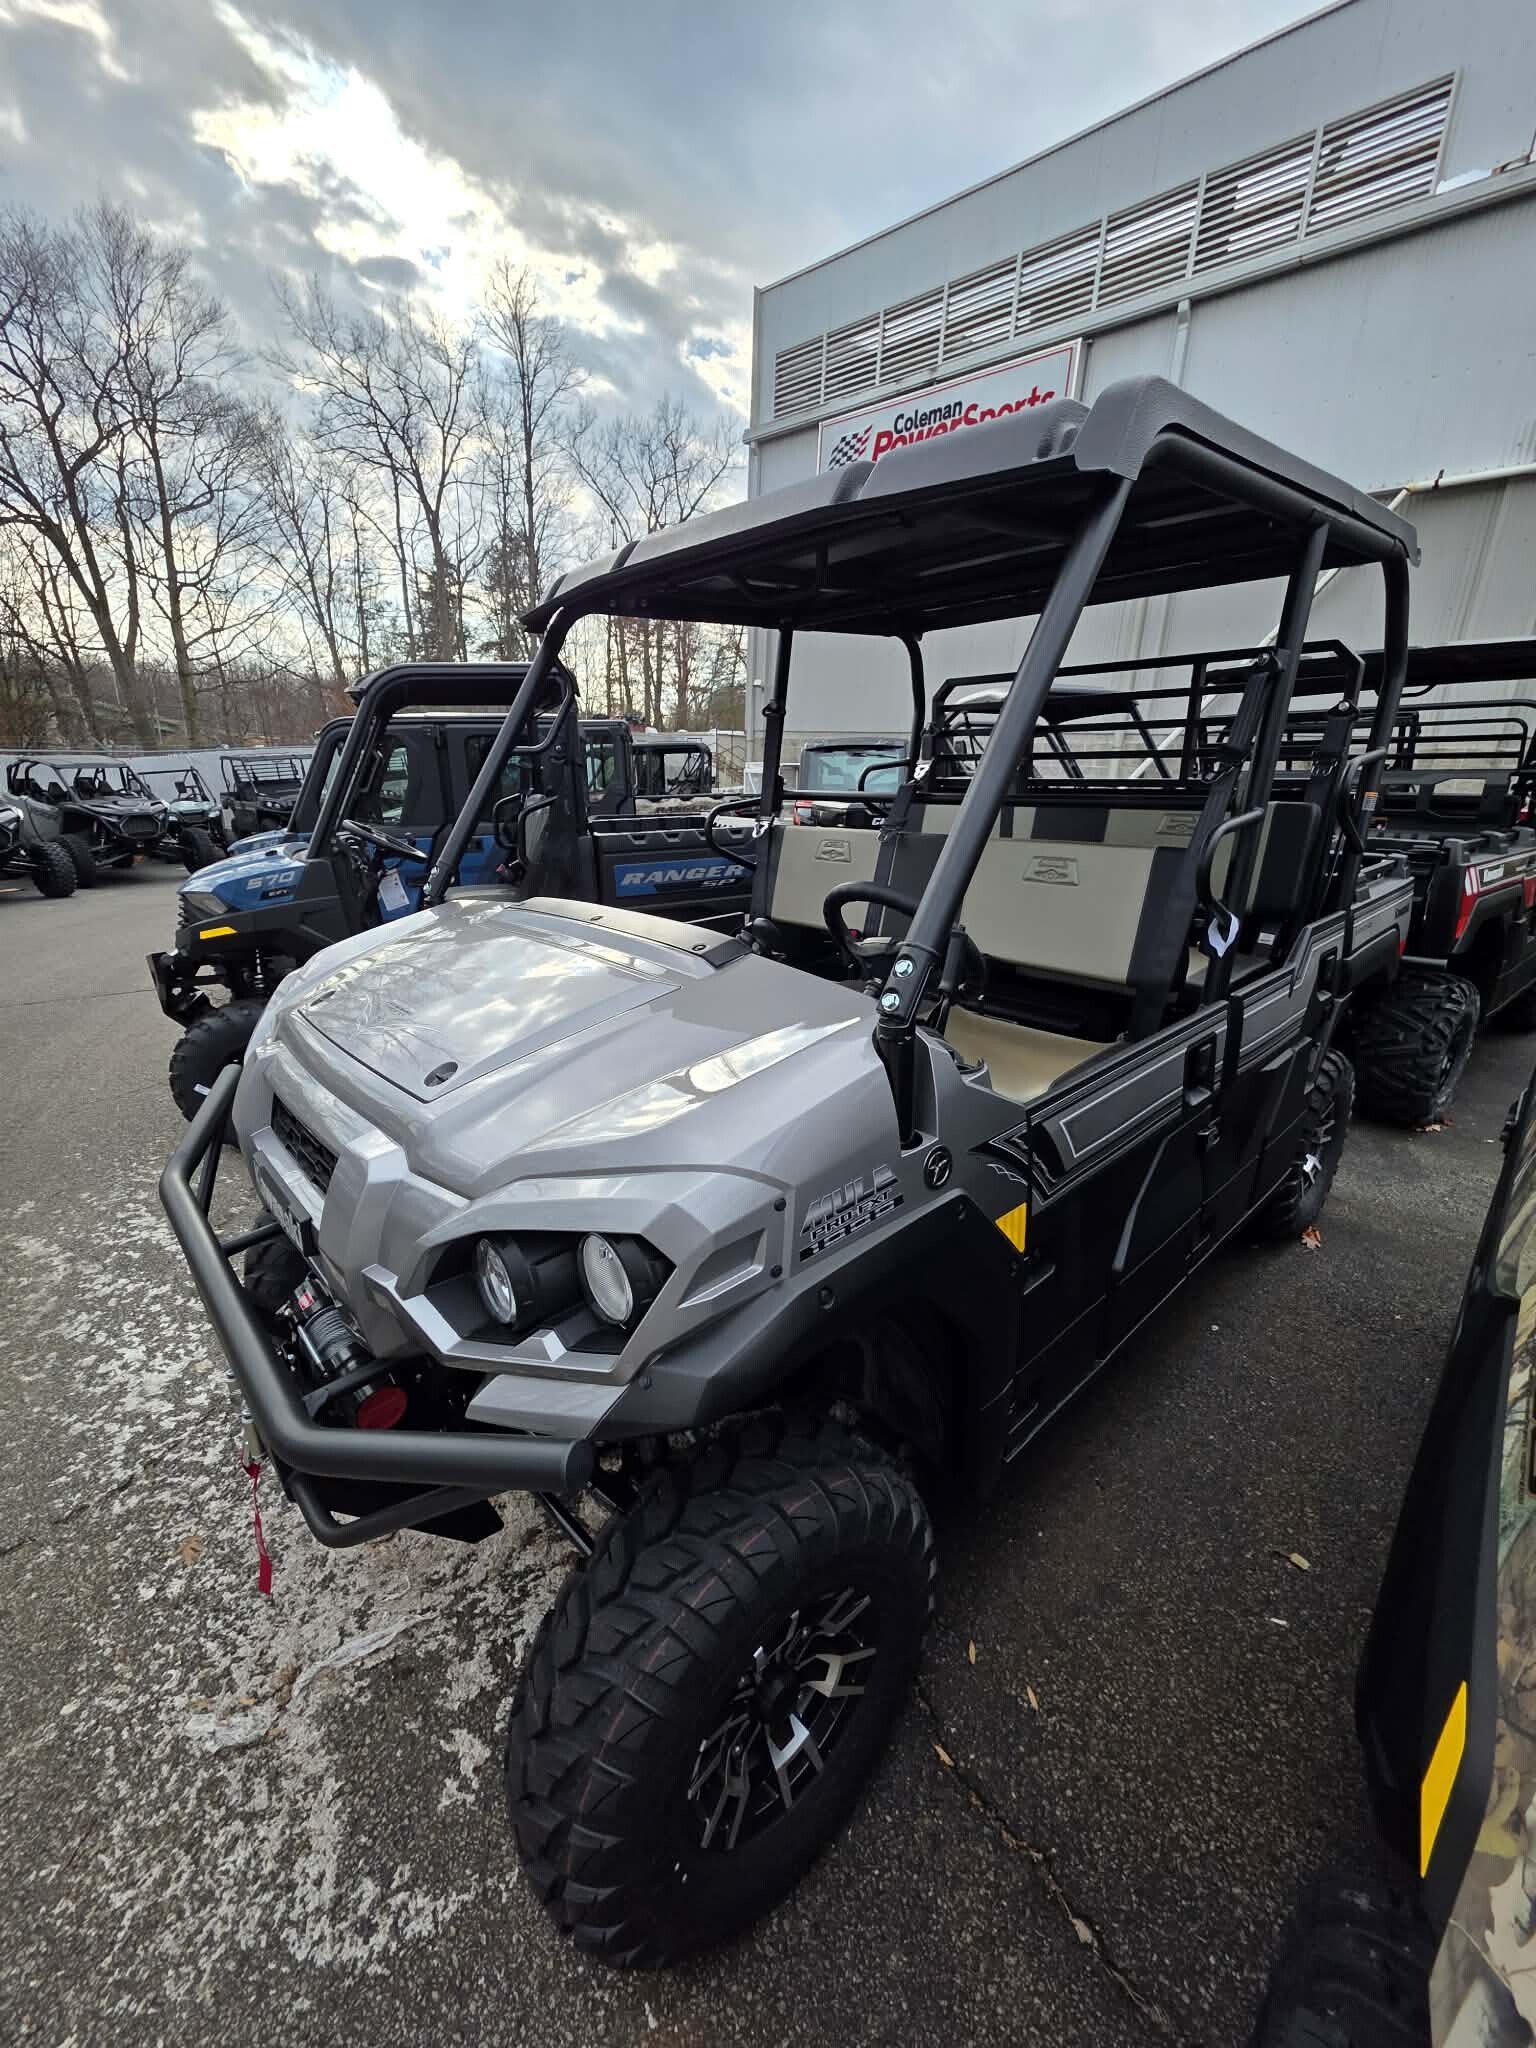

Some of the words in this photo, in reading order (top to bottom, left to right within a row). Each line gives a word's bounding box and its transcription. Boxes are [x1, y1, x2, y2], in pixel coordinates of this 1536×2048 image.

[893, 401, 963, 435] Coleman
[247, 871, 296, 890] 570
[621, 864, 745, 886] RANGER
